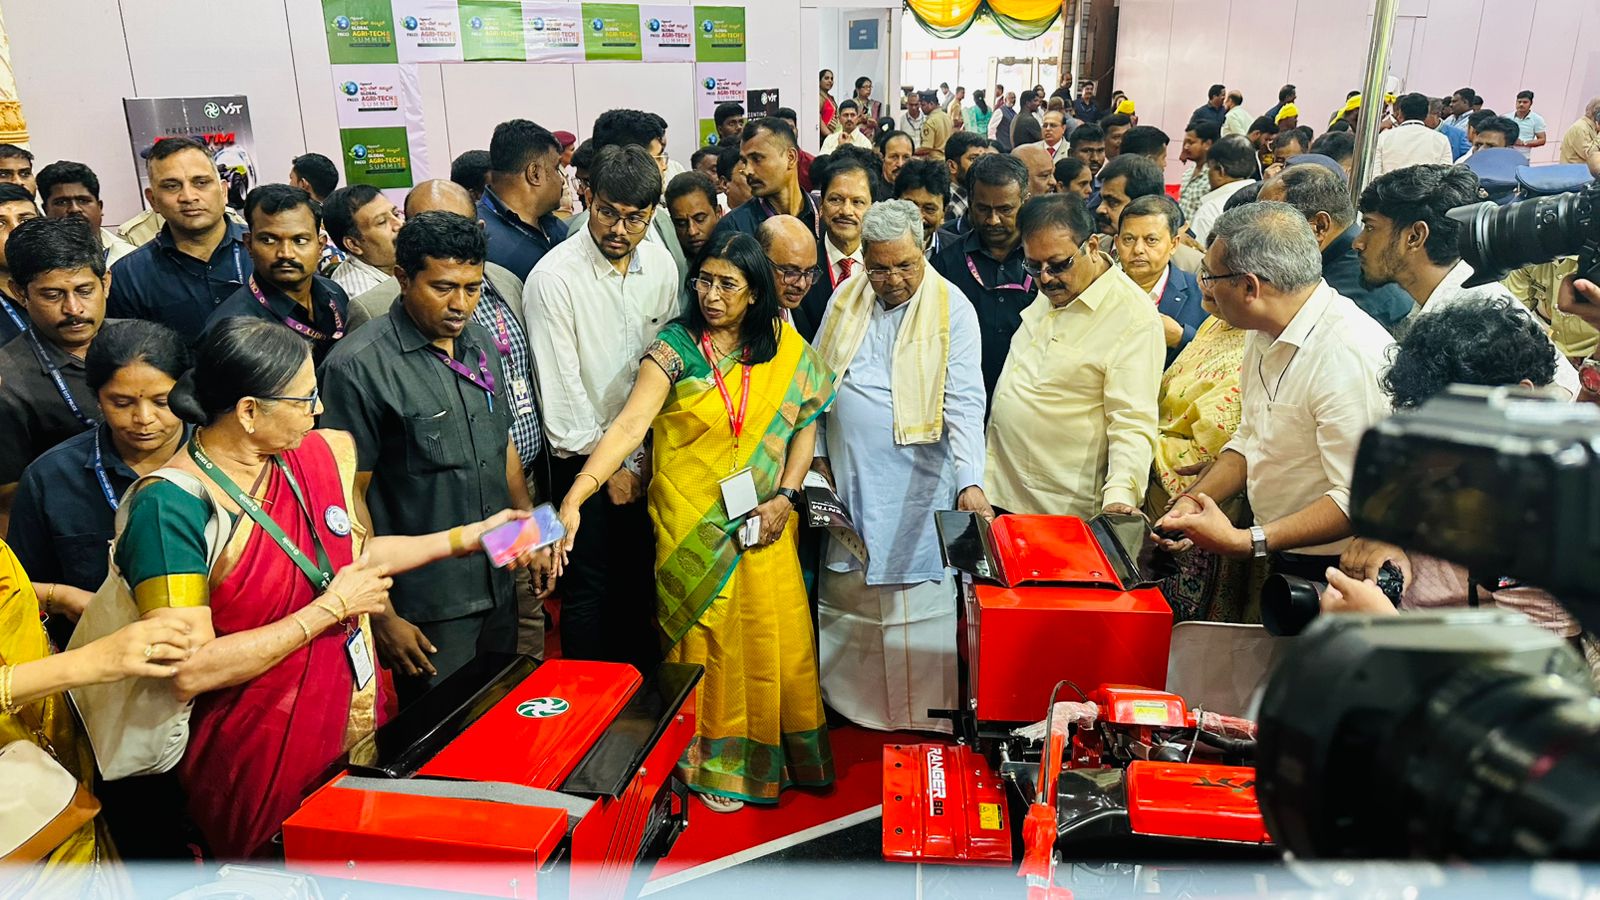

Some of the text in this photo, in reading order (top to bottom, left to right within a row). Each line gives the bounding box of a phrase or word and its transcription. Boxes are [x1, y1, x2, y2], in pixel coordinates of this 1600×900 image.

[221, 102, 243, 114] VST
[165, 126, 225, 135] PRESENTING
[929, 747, 946, 816] RANGER 80
